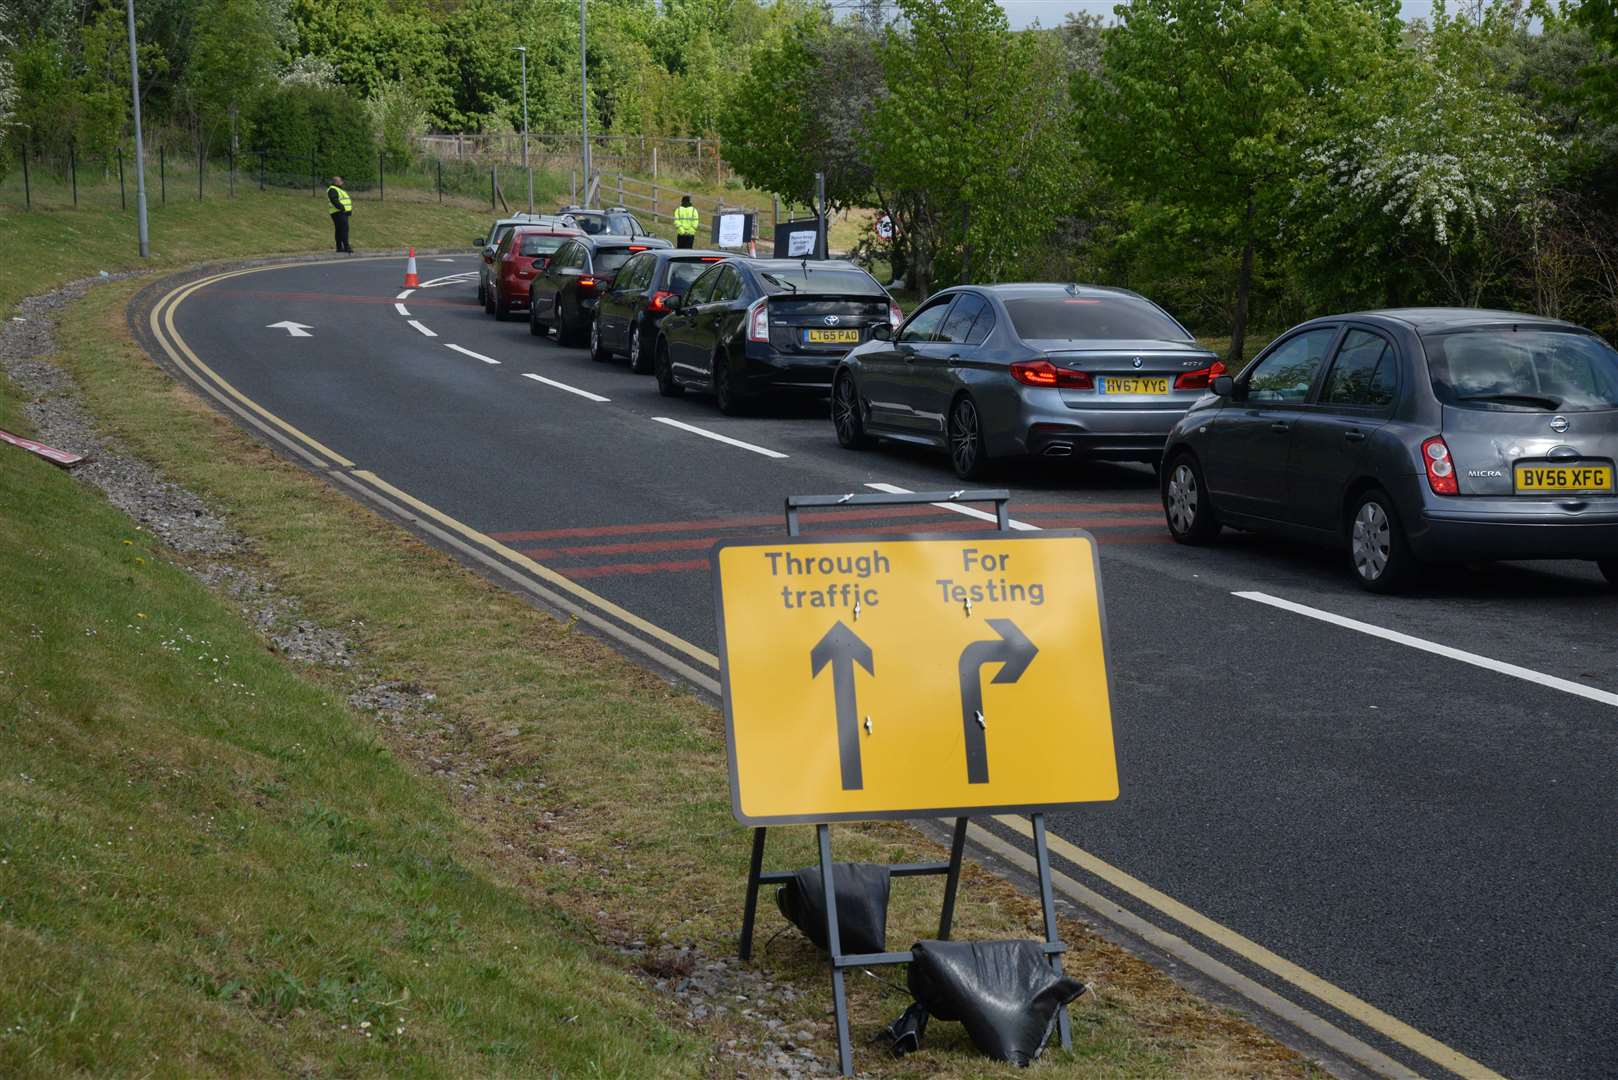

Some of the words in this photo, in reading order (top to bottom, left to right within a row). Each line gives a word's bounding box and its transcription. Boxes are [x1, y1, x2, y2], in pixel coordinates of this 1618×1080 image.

[810, 330, 836, 341] LT65
[1107, 379, 1139, 392] HV67
[1143, 379, 1166, 392] YYG
[1524, 470, 1567, 486] BV56
[1572, 470, 1604, 486] XFG
[765, 550, 890, 578] Through
[962, 549, 1010, 573] For
[781, 584, 879, 609] traffic
[936, 579, 1045, 606] Testing
